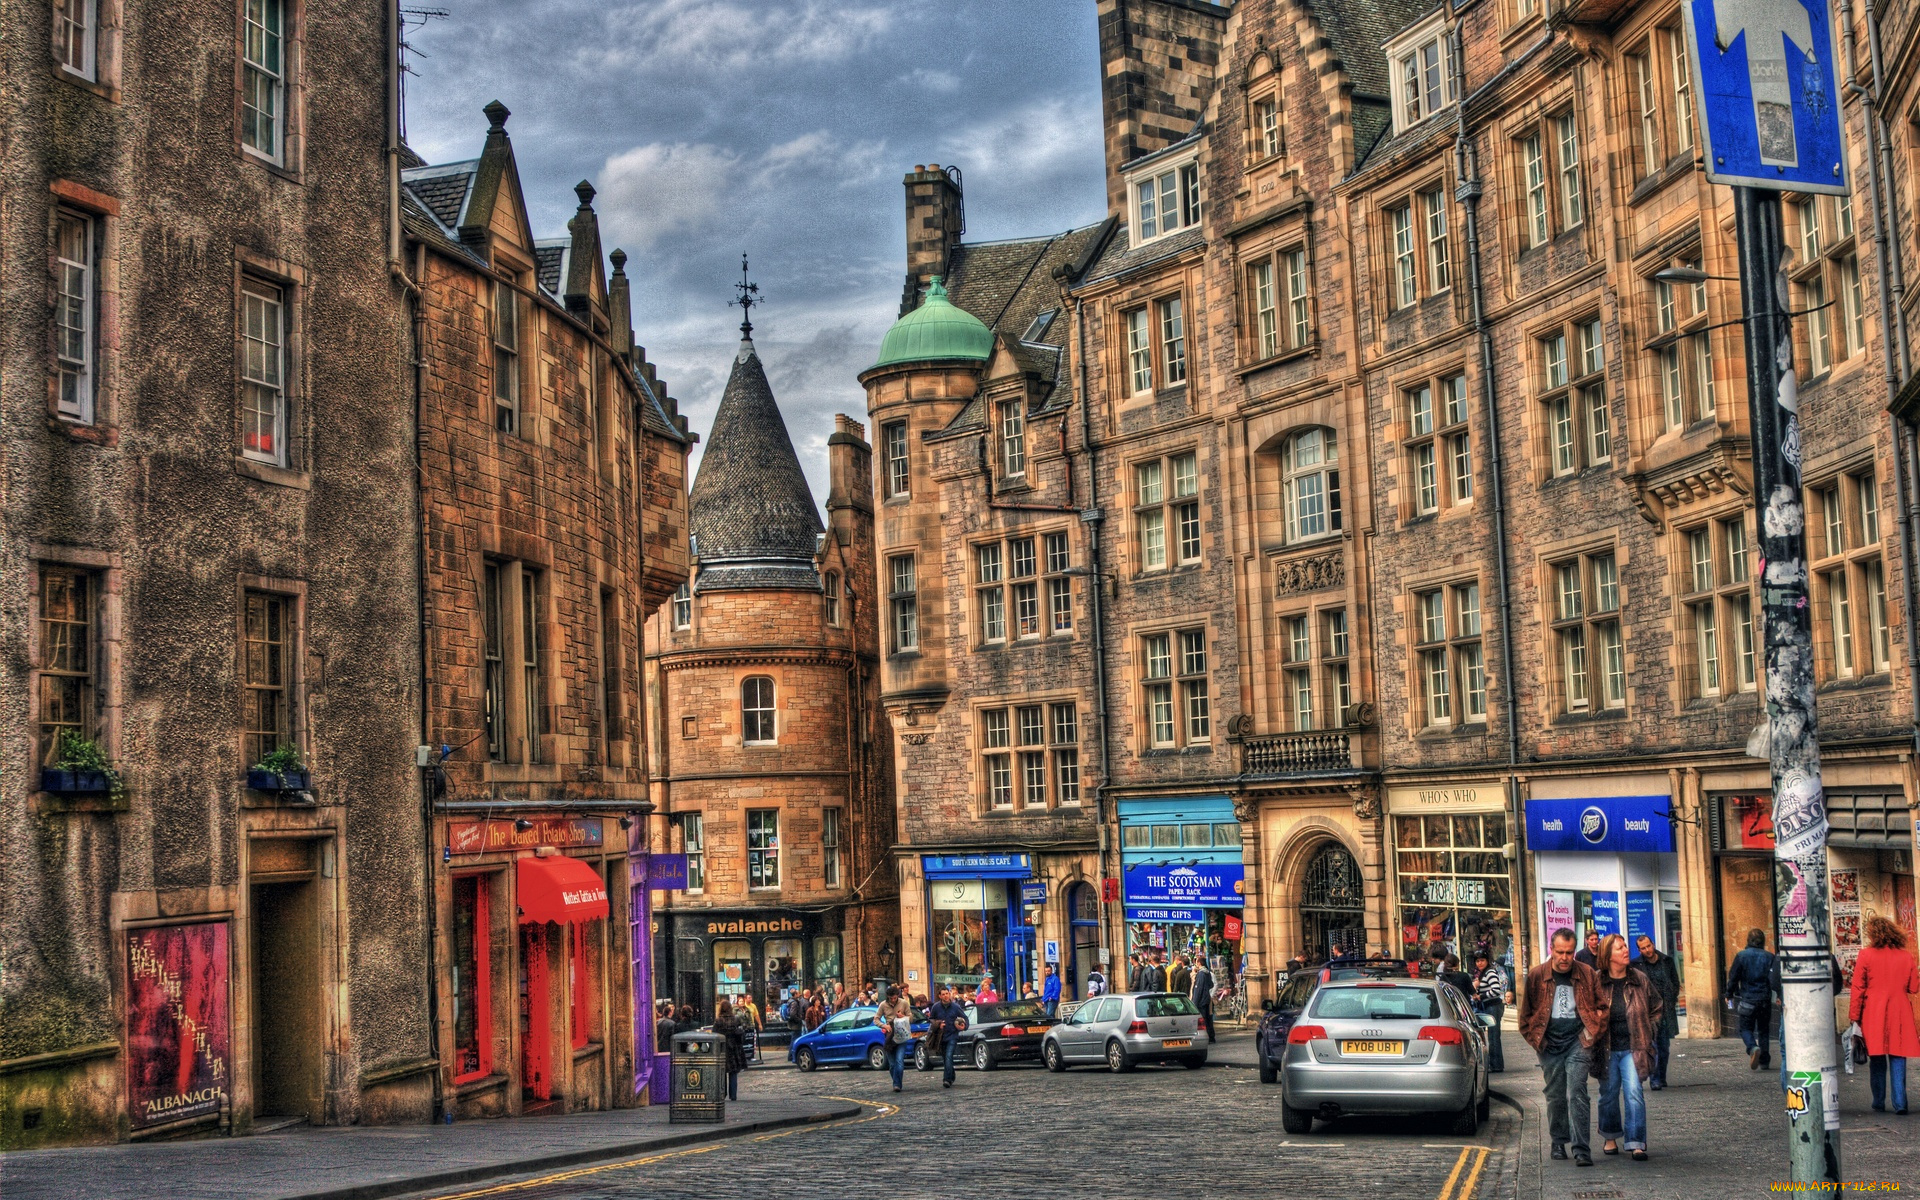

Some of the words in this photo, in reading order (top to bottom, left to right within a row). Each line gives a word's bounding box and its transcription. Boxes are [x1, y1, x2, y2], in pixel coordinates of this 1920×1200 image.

[1419, 790, 1449, 804] WHO'S
[1454, 789, 1476, 802] WHO
[1543, 819, 1563, 830] health
[1625, 818, 1649, 832] beauty
[489, 824, 505, 846] The
[543, 822, 565, 842] Potato
[569, 822, 585, 845] Shop
[1794, 839, 1811, 851] FRI
[952, 858, 978, 866] SOUTHERN
[980, 858, 995, 866] CROSS
[1147, 876, 1166, 887] THE
[1169, 876, 1221, 887] SCOTSMAN
[563, 891, 581, 905] Hottest
[579, 890, 594, 902] Tattie
[591, 890, 598, 900] in
[596, 888, 608, 900] Town
[1429, 883, 1454, 900] 70%
[1458, 882, 1482, 902] OFF
[1547, 900, 1554, 912] 10
[1555, 906, 1569, 914] points
[1594, 898, 1619, 909] welcome
[1138, 910, 1168, 918] SCOTTISH
[1555, 917, 1566, 925] every
[707, 918, 803, 934] avalanche
[1347, 1042, 1374, 1051] FY08
[1378, 1042, 1397, 1052] UBT
[146, 1086, 221, 1113] ALBANACH
